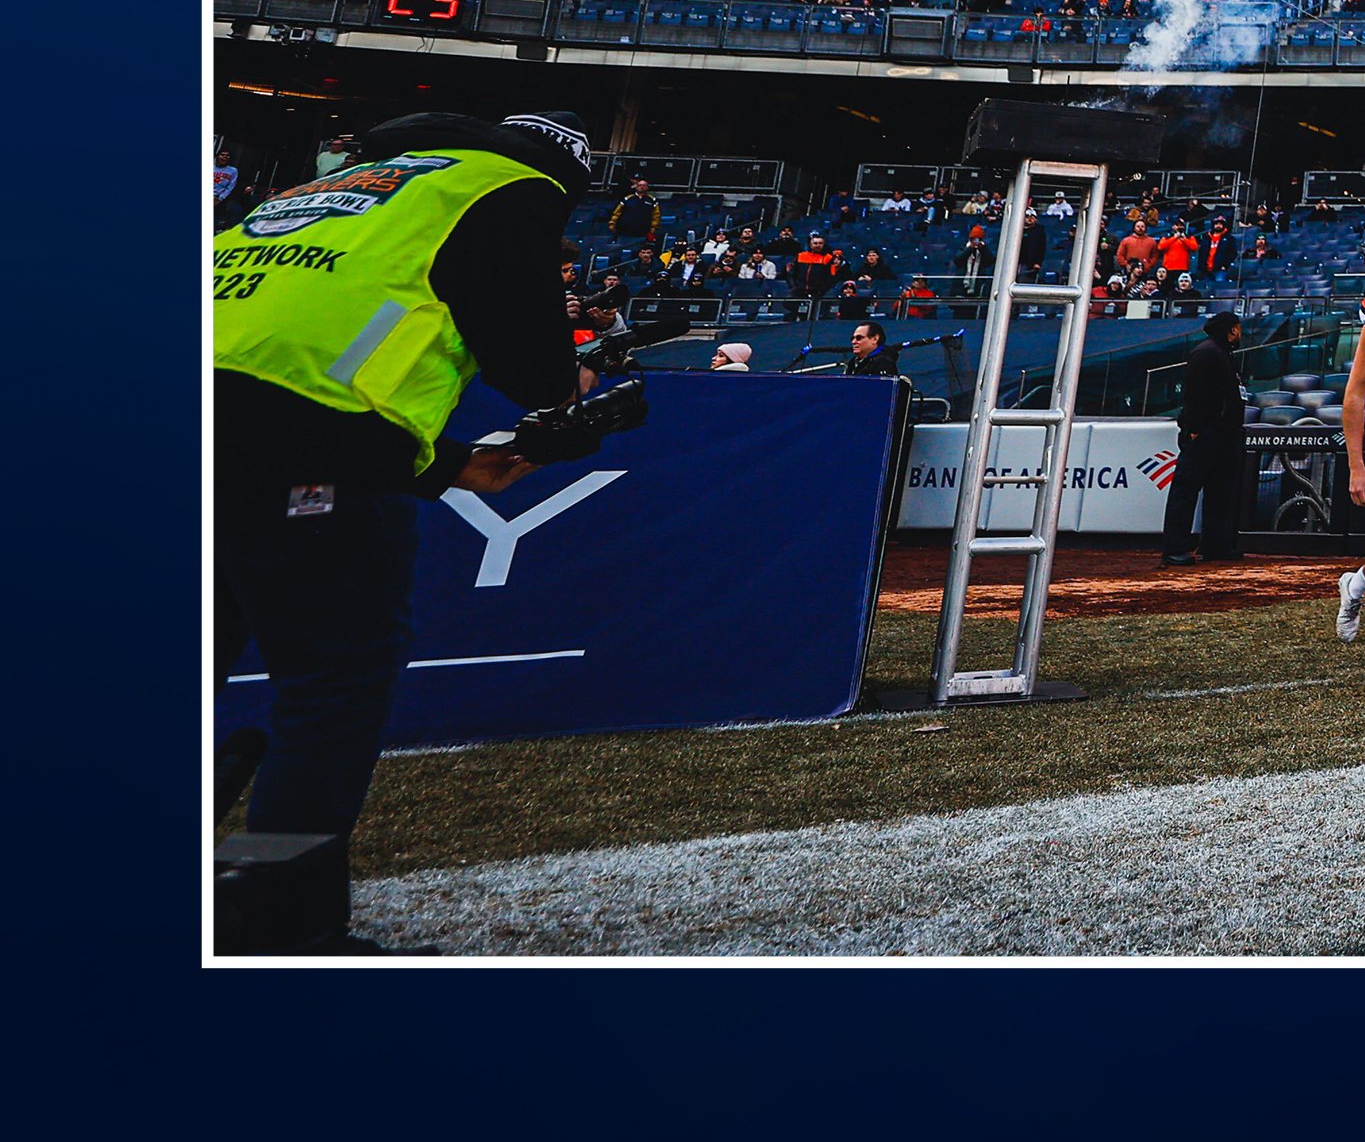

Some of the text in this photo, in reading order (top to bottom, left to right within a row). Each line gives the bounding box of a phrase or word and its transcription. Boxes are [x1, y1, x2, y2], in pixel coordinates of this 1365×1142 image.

[325, 194, 374, 212] BOWL
[1245, 435, 1330, 446] BANK OF AMERICA
[909, 467, 957, 488] BAN
